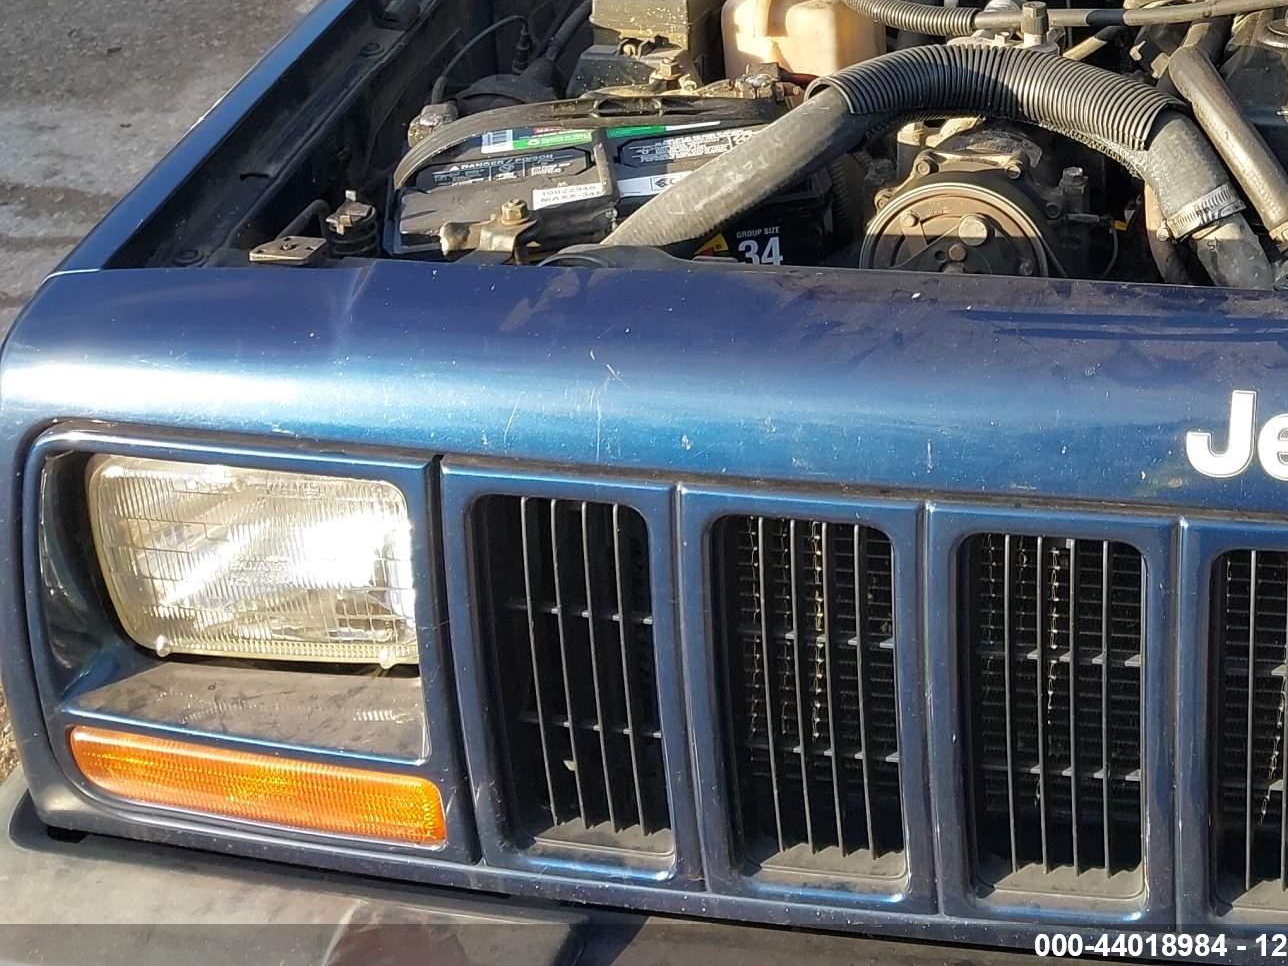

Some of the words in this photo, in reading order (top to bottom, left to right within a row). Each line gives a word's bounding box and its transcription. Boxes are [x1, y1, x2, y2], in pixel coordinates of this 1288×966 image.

[736, 228, 762, 239] GROUP
[763, 226, 780, 235] SIZE
[737, 236, 784, 266] 34
